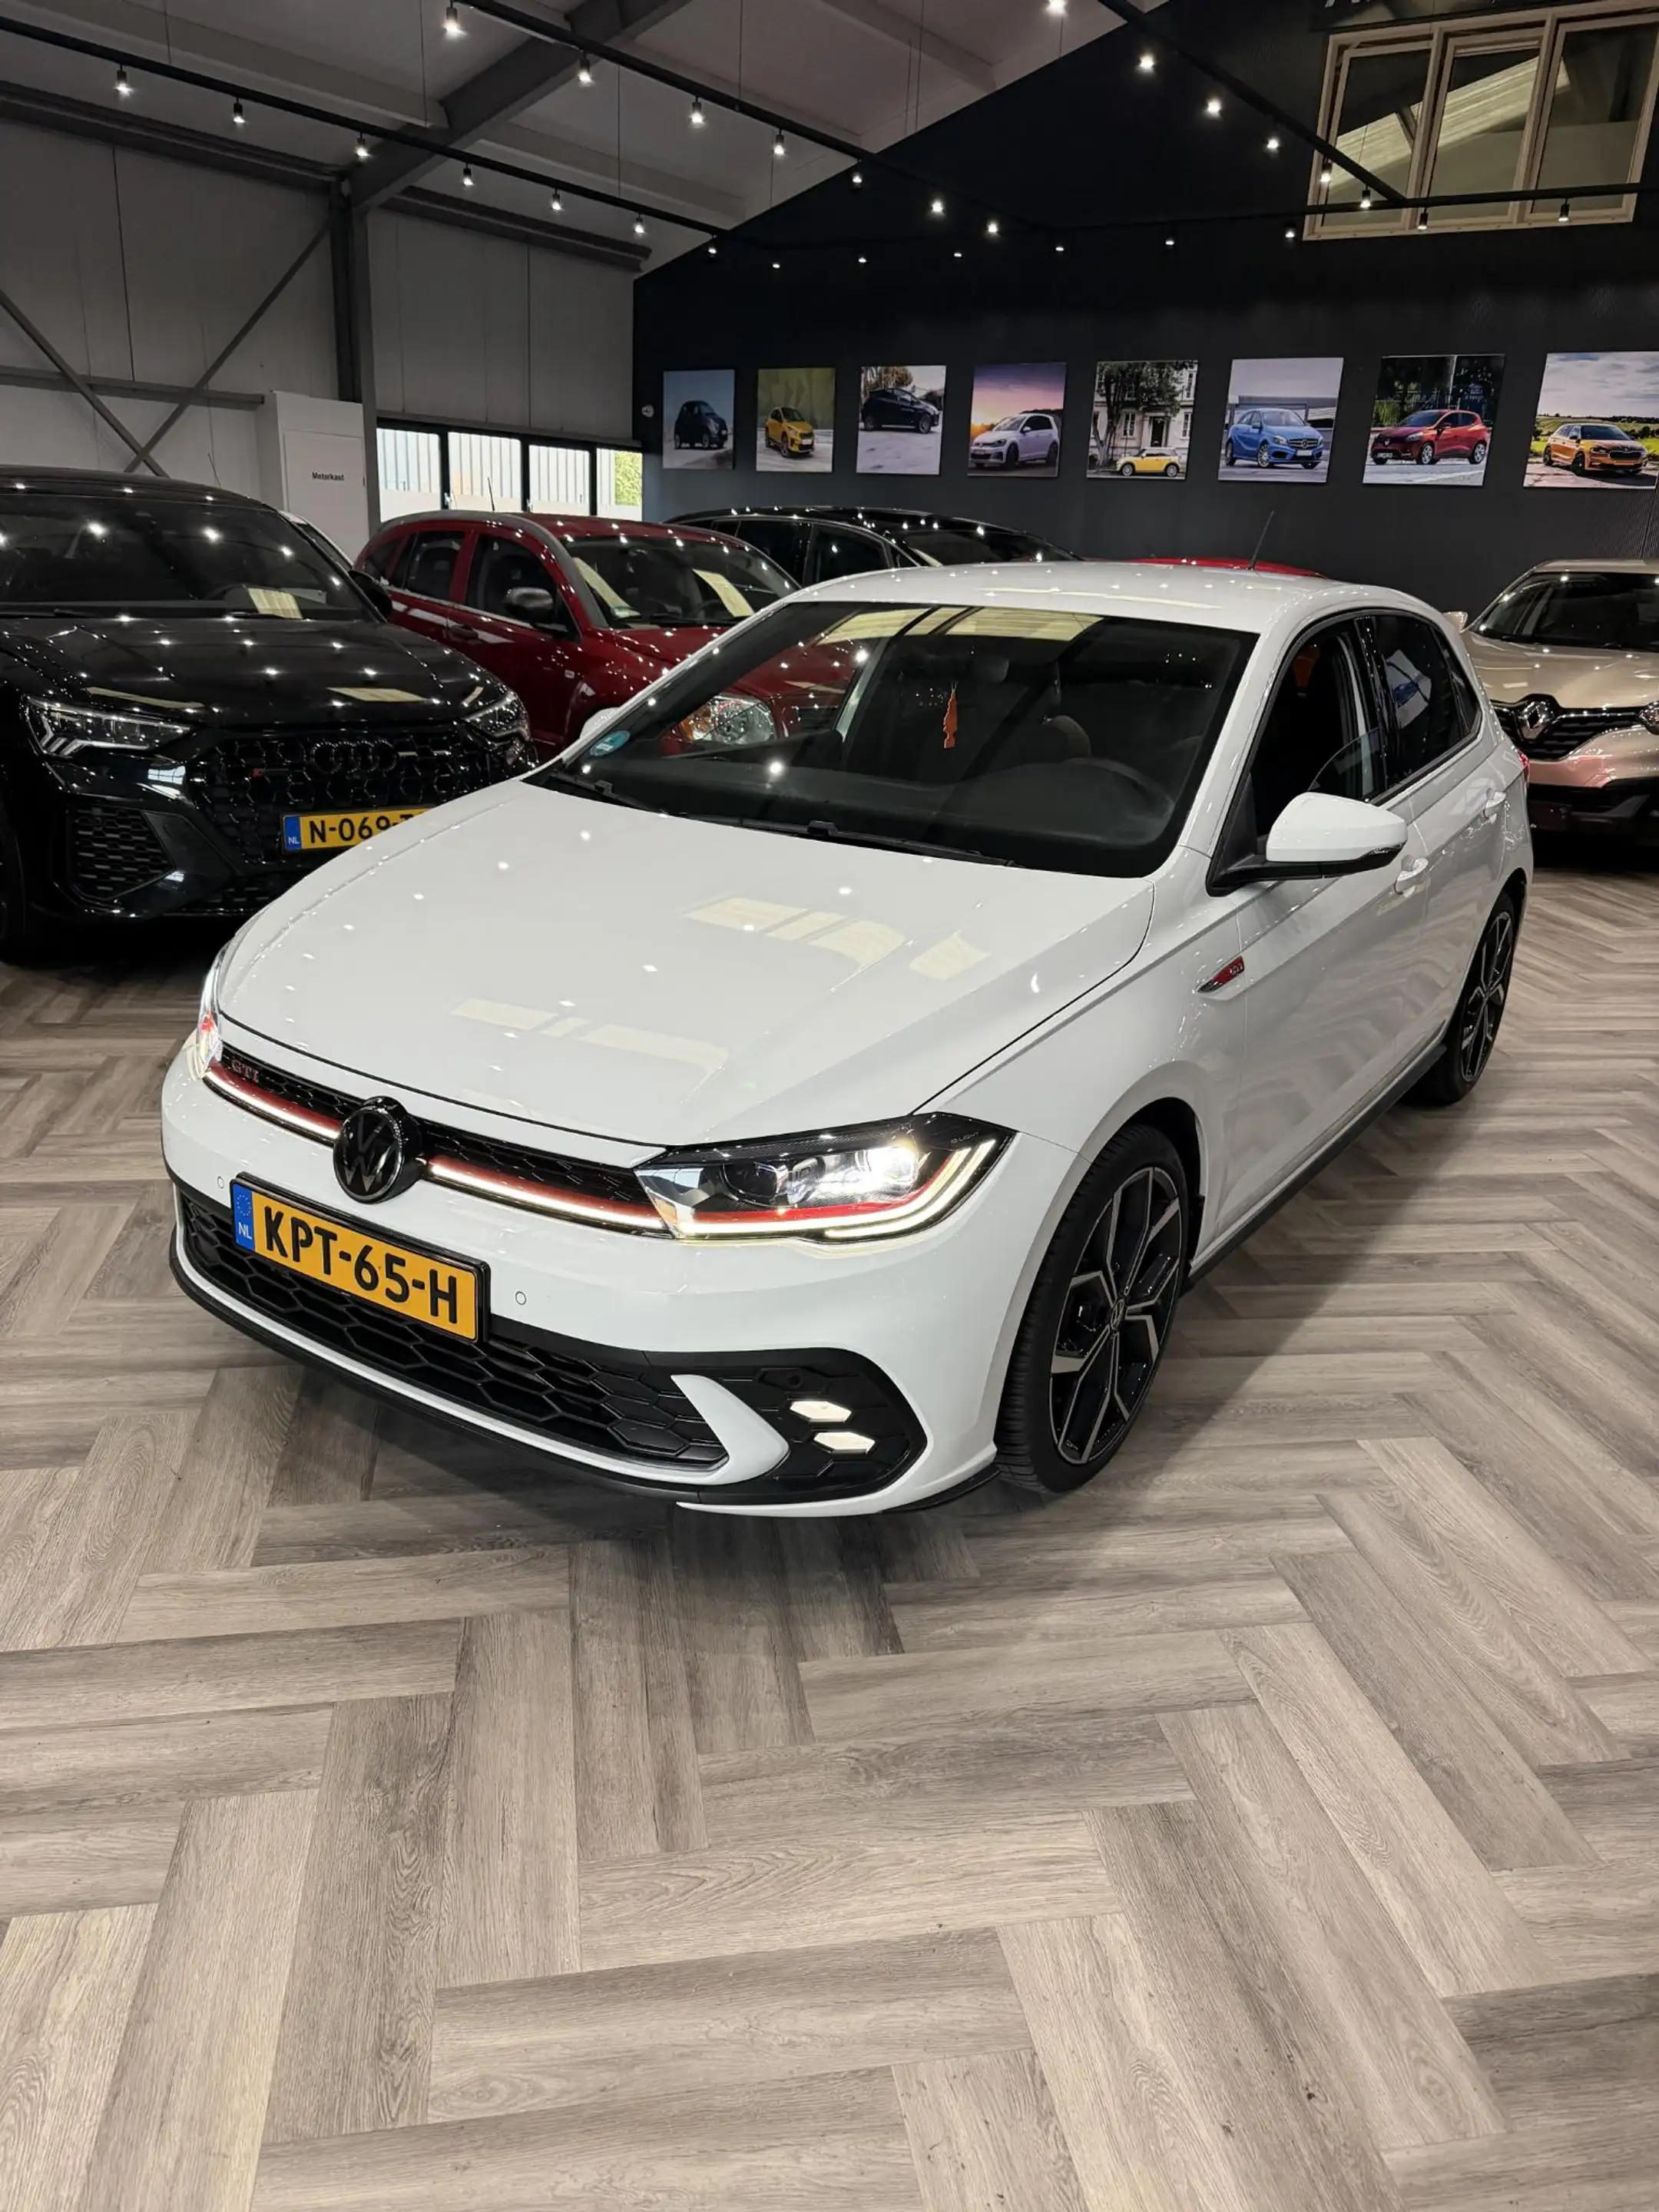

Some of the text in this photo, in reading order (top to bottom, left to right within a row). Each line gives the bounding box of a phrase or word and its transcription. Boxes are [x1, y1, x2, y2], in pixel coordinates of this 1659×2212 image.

[312, 471, 345, 482] Meterkast
[288, 836, 300, 845] NL
[232, 1060, 259, 1083] GTI
[238, 1206, 458, 1323] NL KPT-65-H
